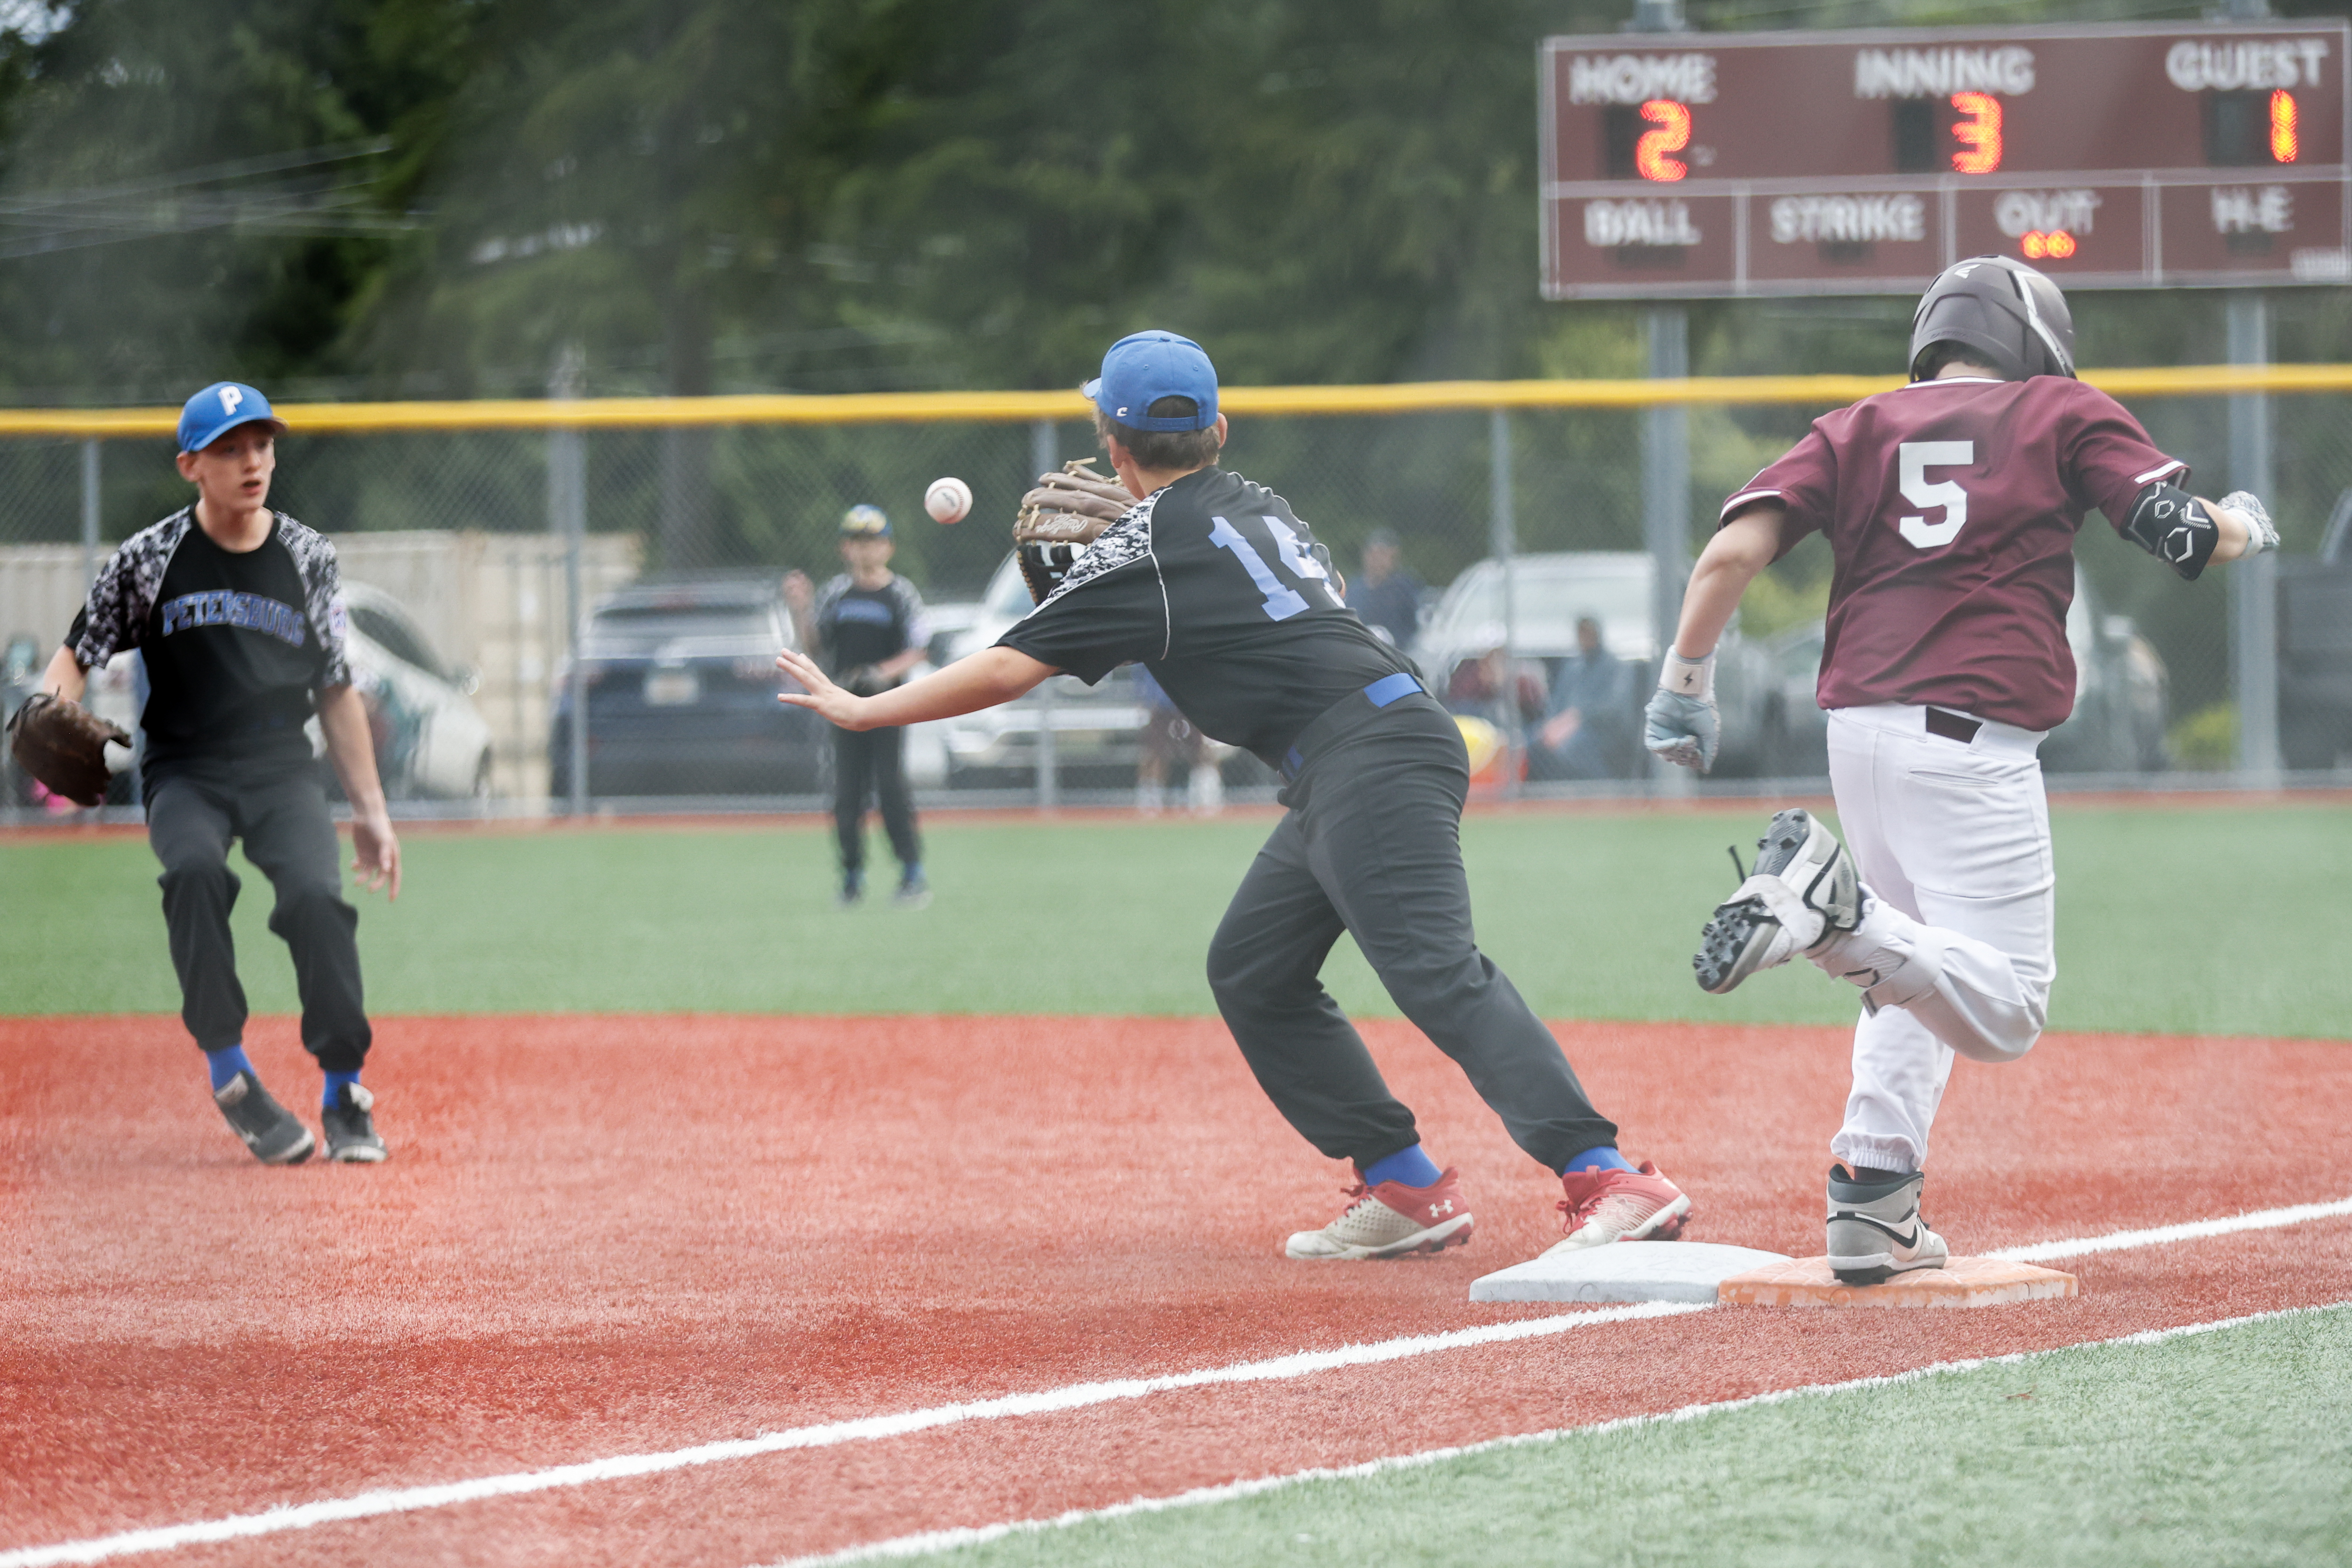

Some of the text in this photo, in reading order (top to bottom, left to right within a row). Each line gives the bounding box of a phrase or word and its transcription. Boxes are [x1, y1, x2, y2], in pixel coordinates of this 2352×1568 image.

[1569, 54, 1717, 104] HOME
[1855, 46, 2036, 99] INNING
[2167, 40, 2329, 91] GUEST
[1637, 100, 1691, 182] 2
[1952, 92, 2002, 174] 3
[2270, 89, 2297, 162] 1
[1584, 199, 1702, 246] BALL
[1770, 194, 1925, 244] STRIKE
[1994, 189, 2102, 238] OUT
[218, 386, 243, 416] P
[1898, 440, 1974, 549] 5
[162, 589, 306, 648] PETERSBURG
